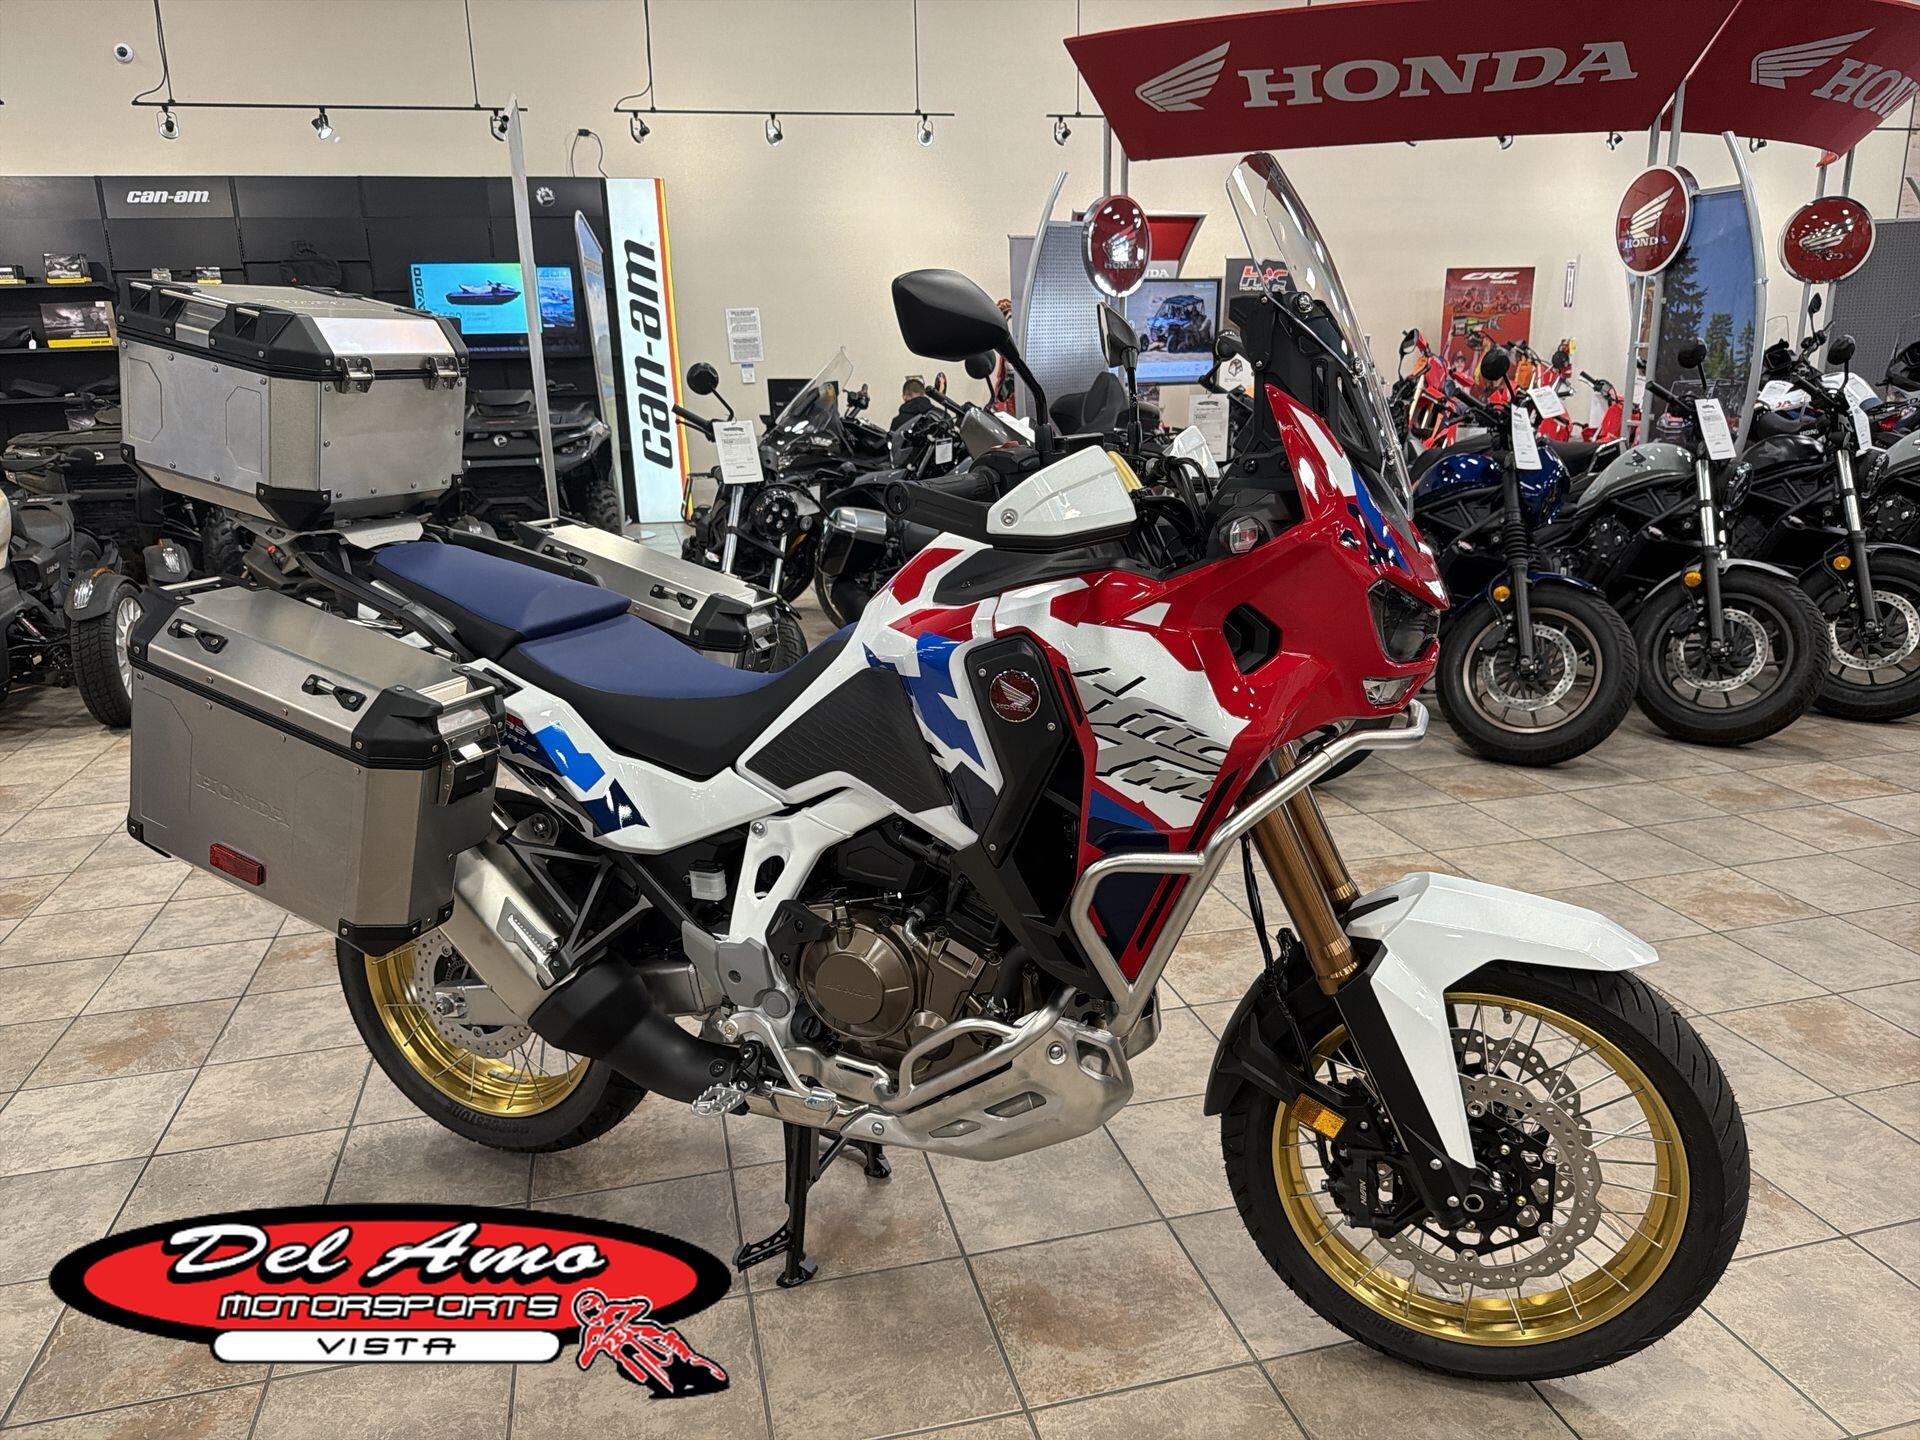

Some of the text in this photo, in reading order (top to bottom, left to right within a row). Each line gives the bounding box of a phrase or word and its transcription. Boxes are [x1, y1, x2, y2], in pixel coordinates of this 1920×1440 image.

[1237, 41, 1638, 108] HONDA
[1810, 57, 1920, 119] HON
[126, 190, 210, 203] can-am
[1624, 235, 1669, 249] HONDA
[1104, 260, 1141, 269] HONDA
[1461, 271, 1520, 280] CRF
[624, 239, 673, 469] can-am
[995, 702, 1032, 714] HONDA
